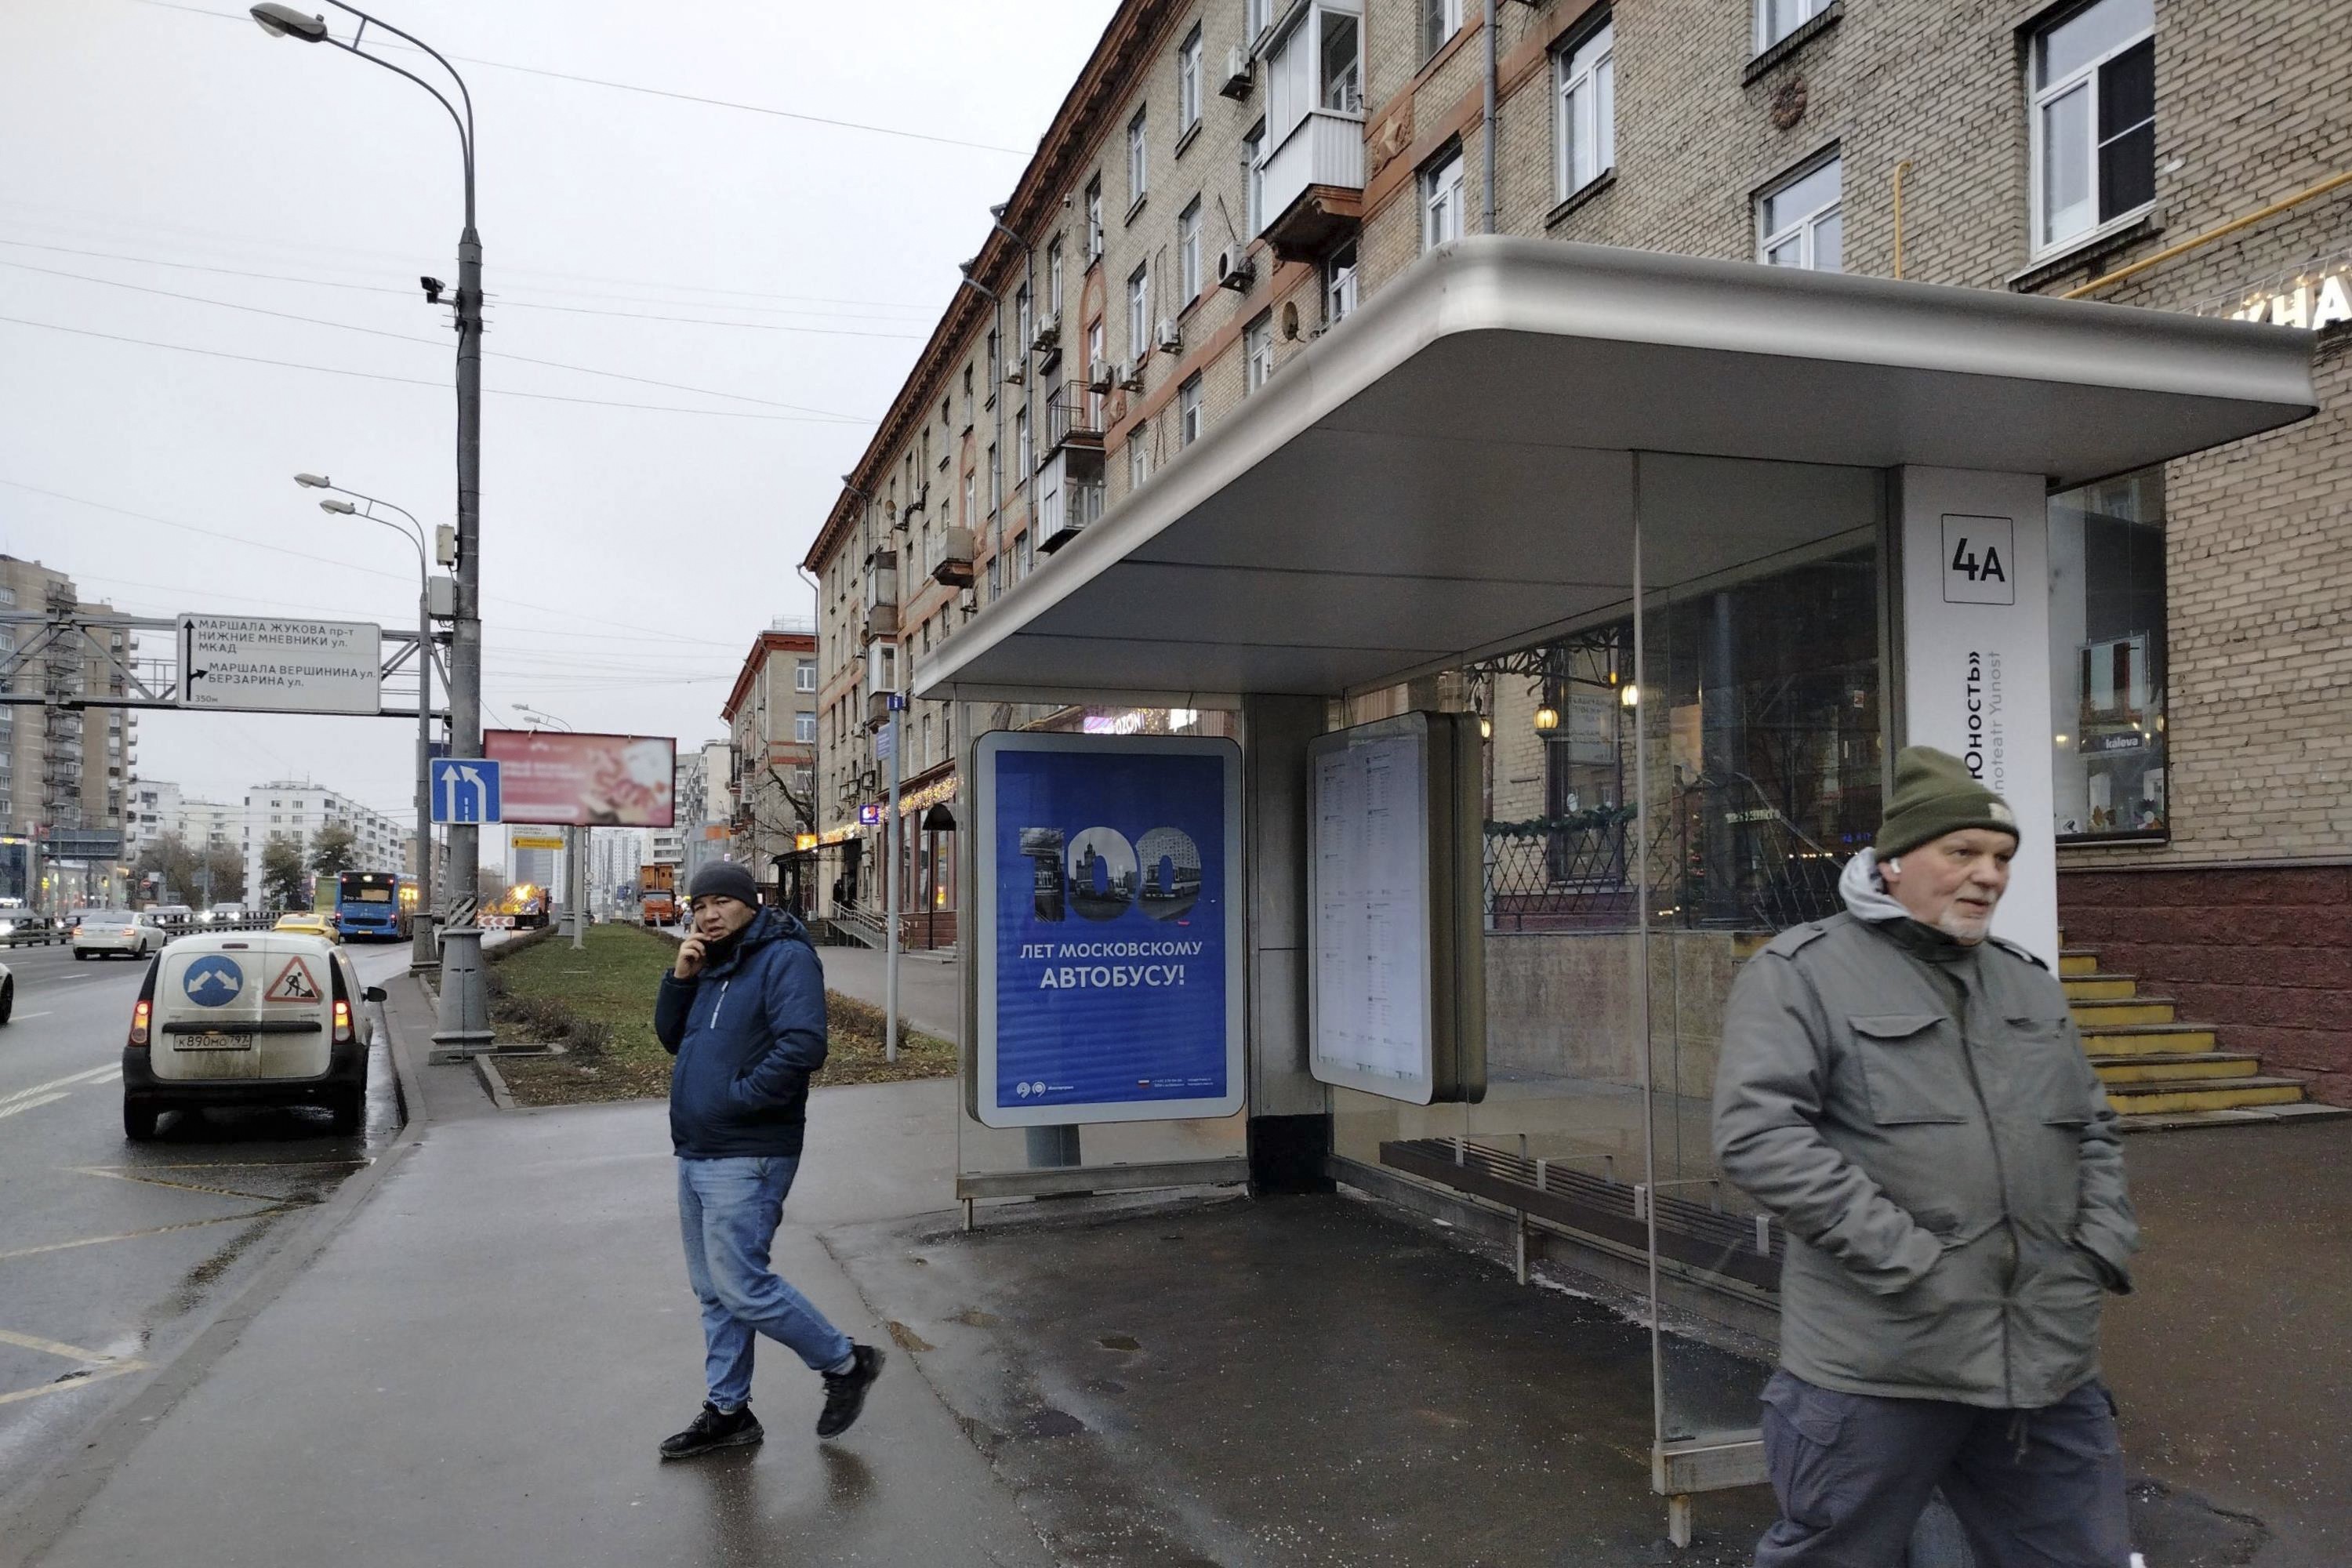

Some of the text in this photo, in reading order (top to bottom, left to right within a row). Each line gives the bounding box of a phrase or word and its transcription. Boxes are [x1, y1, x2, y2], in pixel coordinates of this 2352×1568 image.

[199, 620, 354, 637] МАРШАЛА ЖУКОВА пр-т
[198, 631, 348, 648] НИЖНИЕ МНЕВНИКИ ул.
[199, 643, 237, 654] МКАД
[209, 662, 376, 680] МАРШАЛА ВЕРШИНИНА ул.
[208, 673, 304, 688] БЕРЗАРИНА ул.
[1988, 651, 2002, 715] Yunost
[2106, 737, 2139, 749] kaleva
[1019, 826, 1202, 923] 100
[1020, 942, 1203, 958] ЛЕТ МОСКОВСКОМУ
[1040, 965, 1185, 989] АВТОБУСУ!
